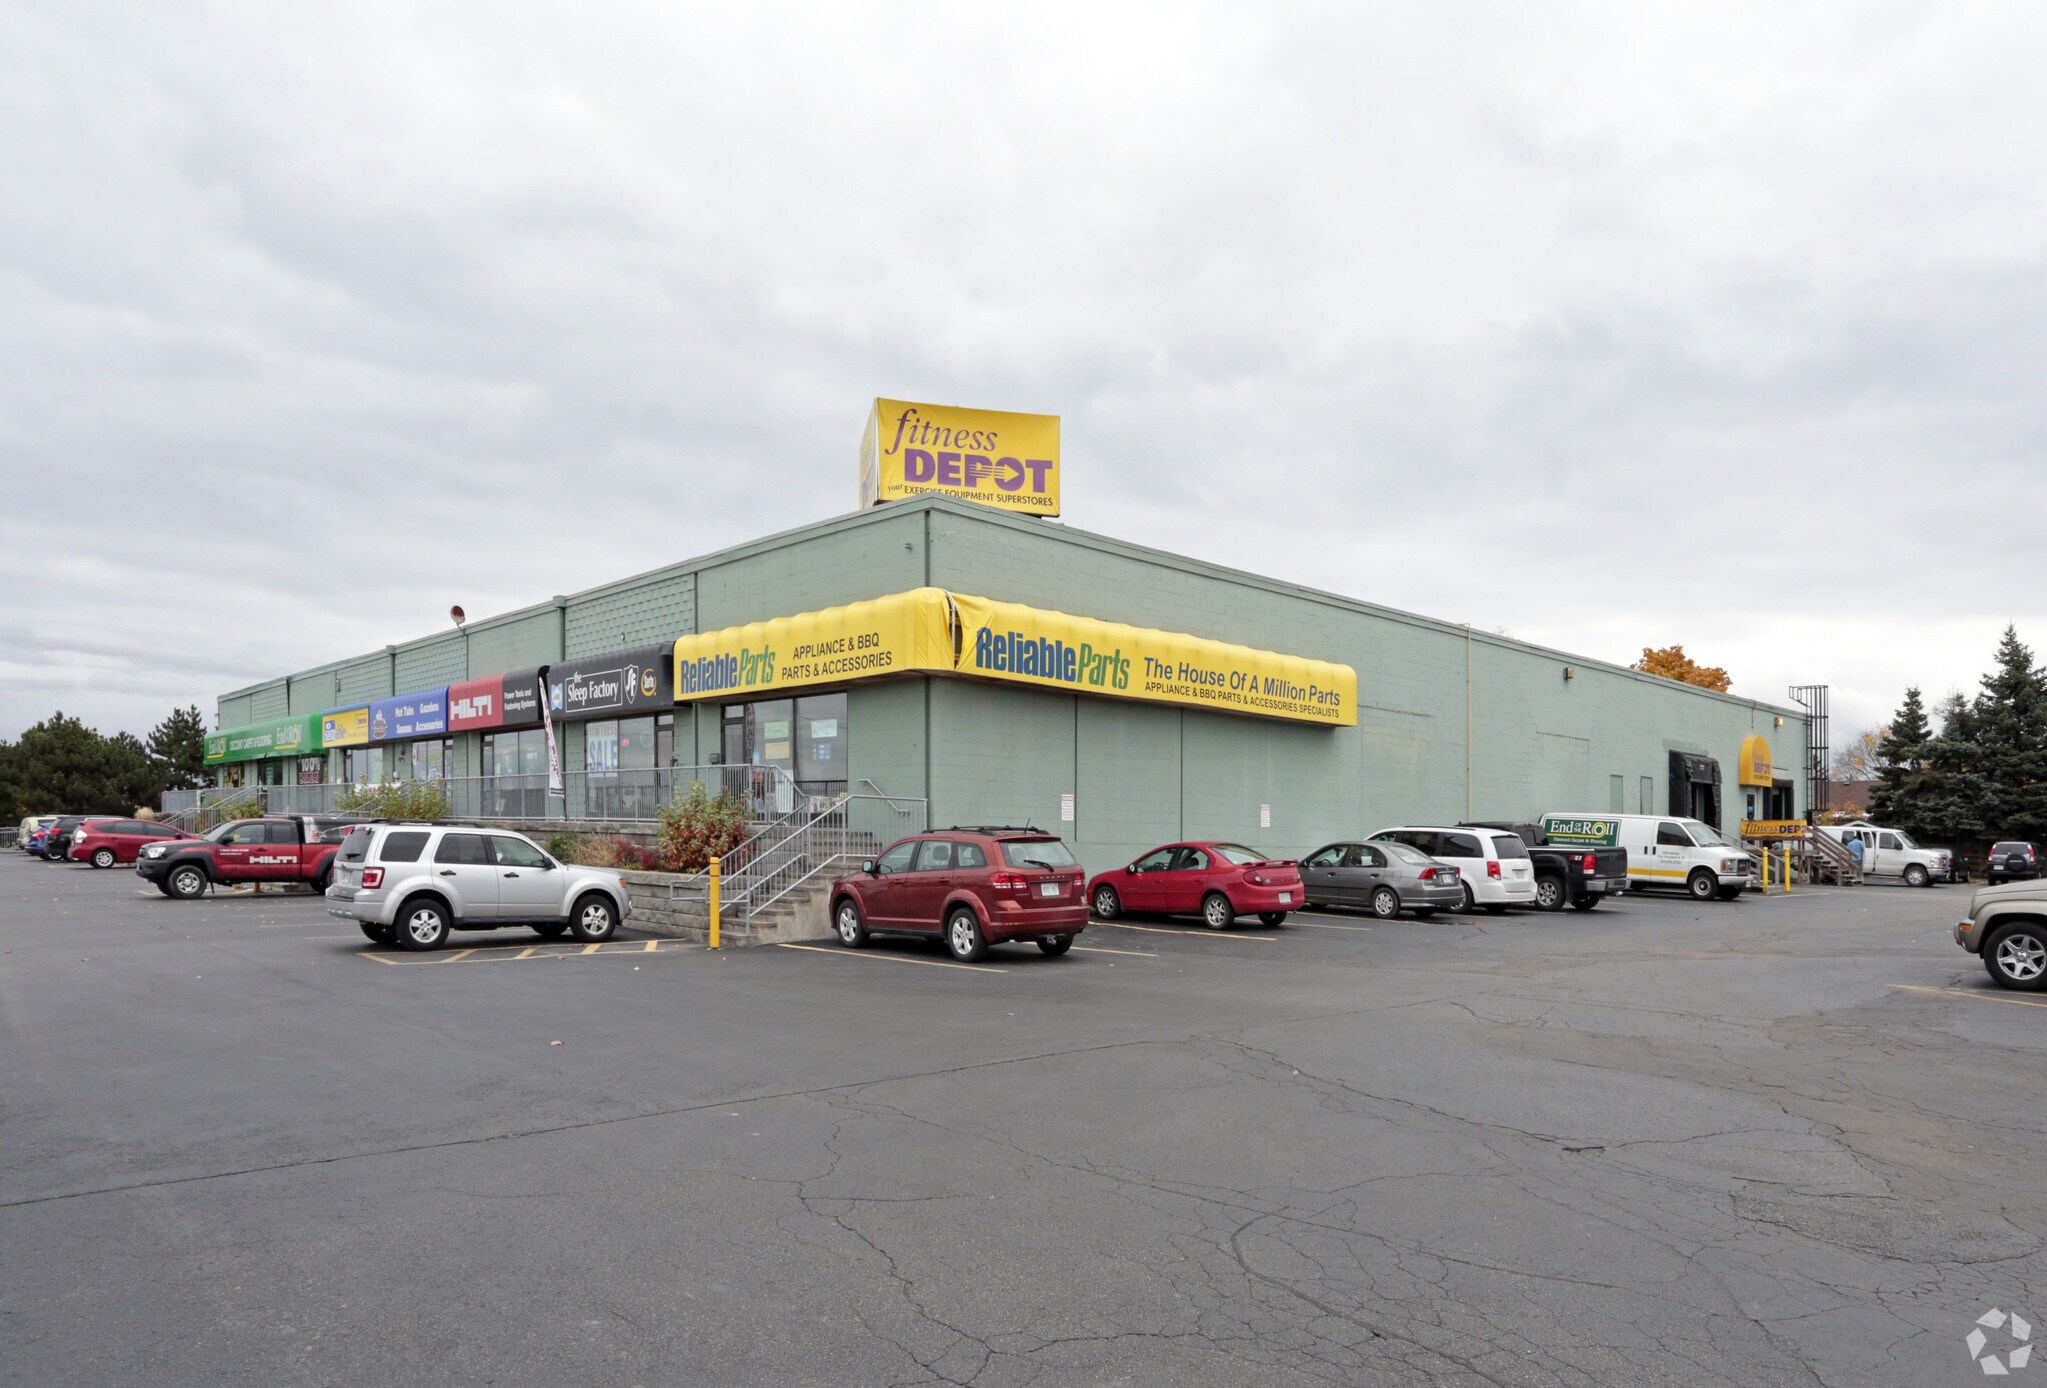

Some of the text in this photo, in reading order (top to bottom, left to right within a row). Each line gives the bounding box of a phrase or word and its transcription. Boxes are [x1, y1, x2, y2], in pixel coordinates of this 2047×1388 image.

[884, 408, 998, 455] fitness
[904, 447, 1053, 493] DEPOT
[887, 484, 903, 493] your
[945, 489, 994, 501] EQUIPMENT
[996, 493, 1053, 507] SUPERSTORES
[793, 632, 880, 660] APPLIANCE & BBQ
[781, 650, 892, 680] PARTS & ACCESSORIES
[573, 671, 582, 683] the
[1144, 657, 1340, 706] The House Of A Million Parts
[515, 689, 525, 698] Tools
[521, 699, 536, 710] Systems
[567, 682, 588, 706] Sleep
[589, 680, 619, 702] Factory
[1145, 681, 1339, 718] APPLIANCE & BBQ PARTS & ACCESSORIES SPECIALISTS
[403, 705, 415, 716] Tubs
[420, 701, 439, 714] Gazebos
[450, 694, 493, 721] HILTI
[415, 718, 444, 731] Accessories
[588, 739, 618, 771] SALE
[1550, 820, 1574, 833] End
[1745, 822, 1807, 836] fitness DEP
[249, 855, 297, 864] HILTI
